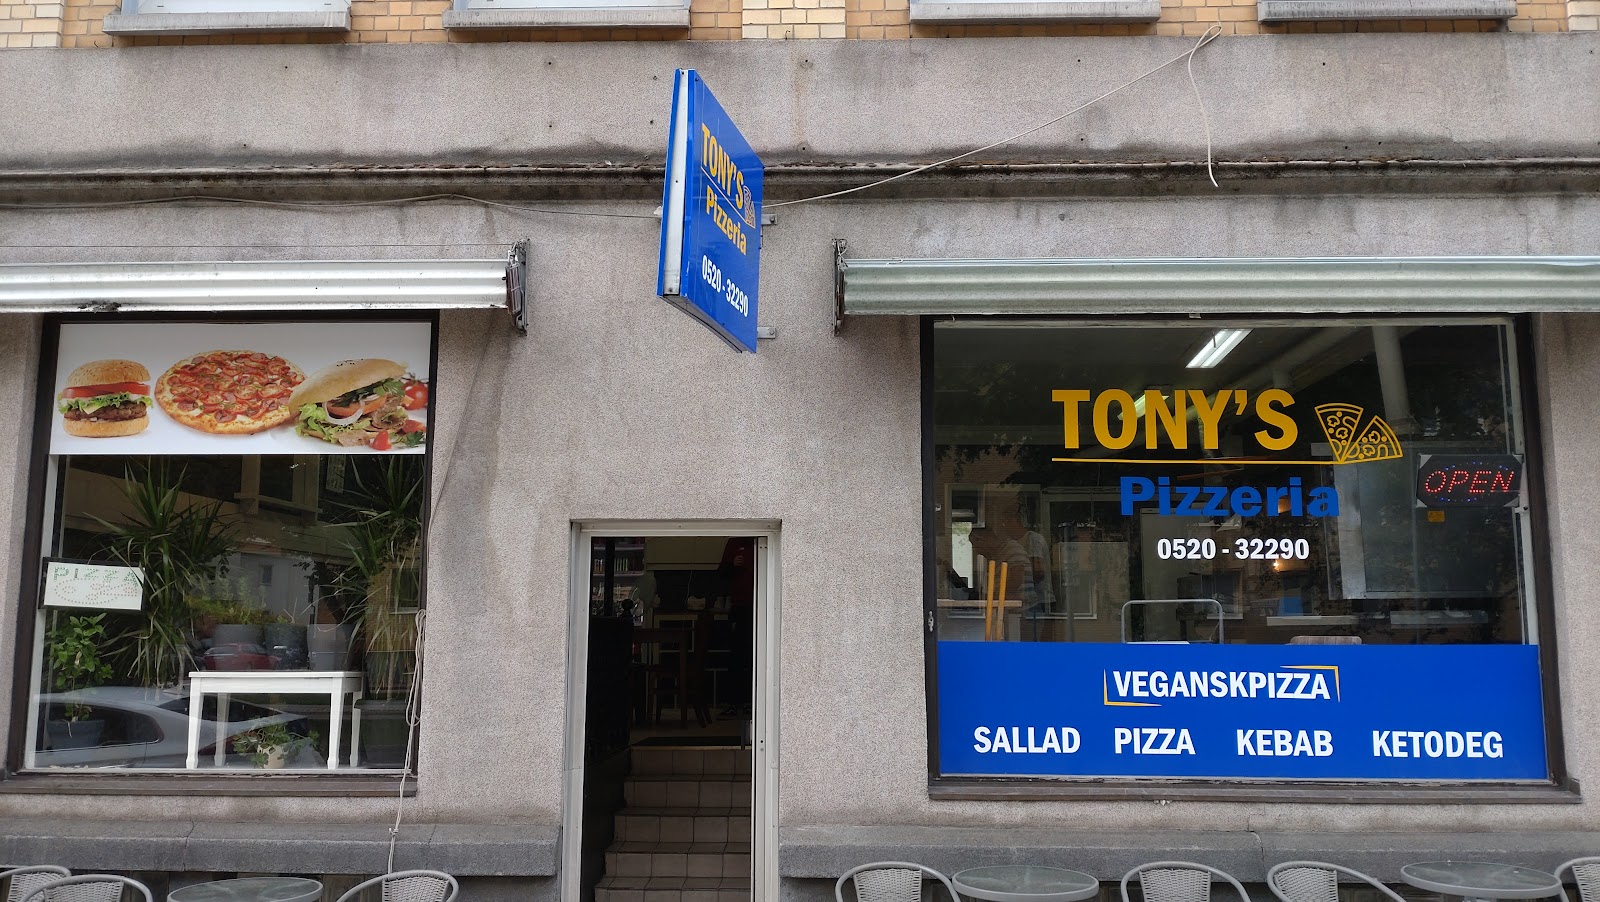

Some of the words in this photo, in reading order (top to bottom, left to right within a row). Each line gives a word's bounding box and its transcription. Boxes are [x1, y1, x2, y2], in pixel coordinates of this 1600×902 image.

[702, 122, 743, 210] TONY'S
[706, 184, 747, 255] Pizzeria
[702, 254, 722, 294] 0520
[726, 279, 749, 318] 32290
[1052, 388, 1298, 451] TONY'S
[1120, 476, 1340, 518] Pizzeria
[1425, 470, 1515, 493] OPEN
[1157, 538, 1216, 560] 0520
[1234, 538, 1310, 560] 32290
[54, 566, 138, 587] PIZZA
[1112, 670, 1331, 700] VEGANSKPIZZA
[973, 726, 1081, 754] SALLAD
[1114, 727, 1196, 755] PIZZA
[1236, 729, 1334, 757] KEBAB
[1372, 730, 1504, 759] KETODEG
